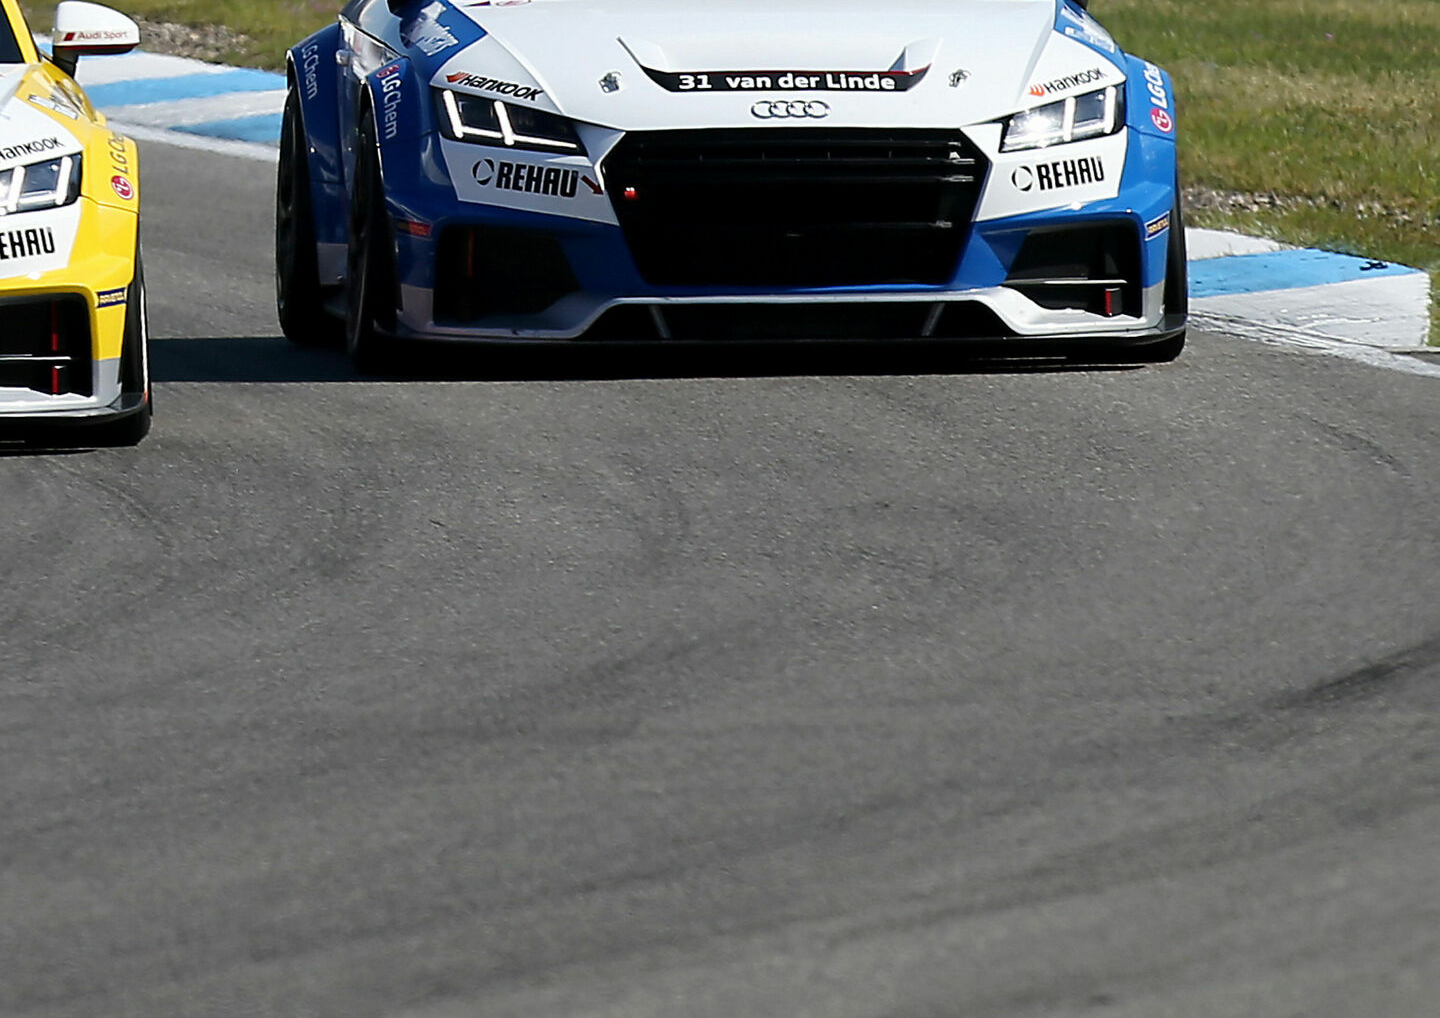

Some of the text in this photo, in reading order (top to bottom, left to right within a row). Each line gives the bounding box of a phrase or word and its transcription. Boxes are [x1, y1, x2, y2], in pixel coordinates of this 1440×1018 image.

[77, 31, 128, 41] Audi Sport
[303, 54, 319, 100] Chem
[678, 73, 896, 90] 31 van der Linde
[381, 73, 402, 140] LG Chem
[496, 159, 580, 199] REHAU
[1036, 155, 1105, 191] REHAU
